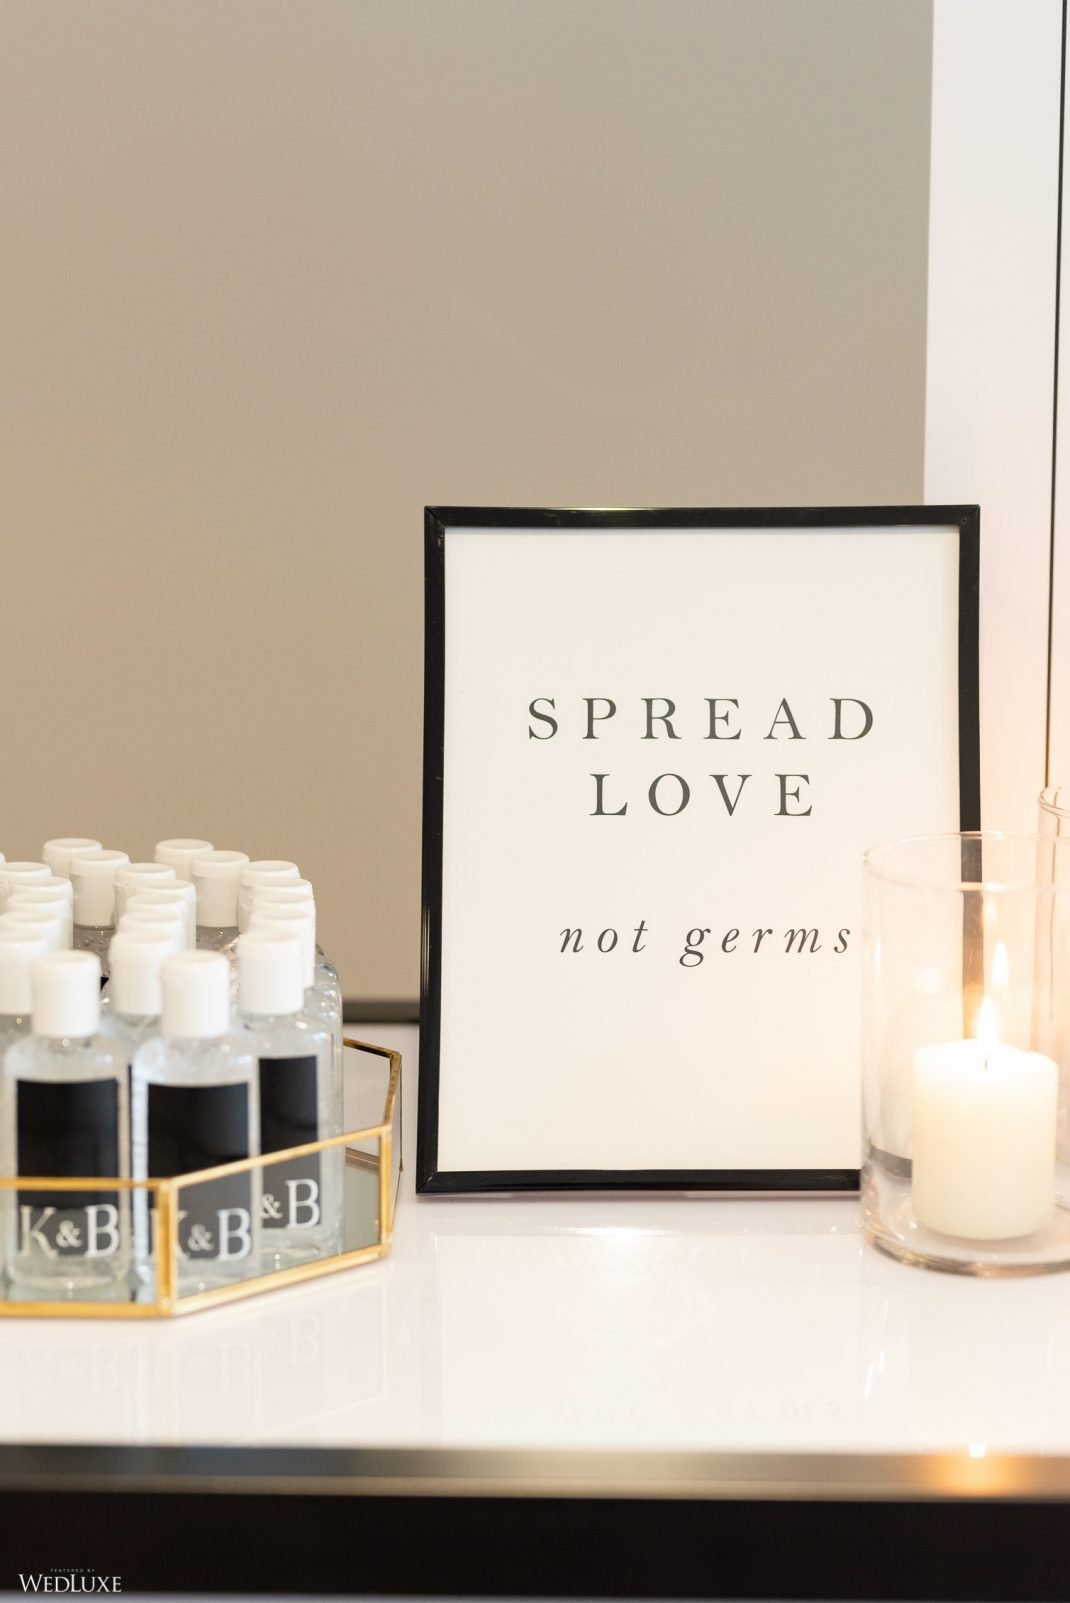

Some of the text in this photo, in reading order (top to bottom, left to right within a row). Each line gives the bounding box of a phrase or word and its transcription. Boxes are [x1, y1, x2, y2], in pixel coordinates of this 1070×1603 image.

[528, 697, 874, 740] SPREAD
[589, 773, 813, 816] LOVE
[560, 920, 851, 968] not germs
[20, 1203, 119, 1257] K&B
